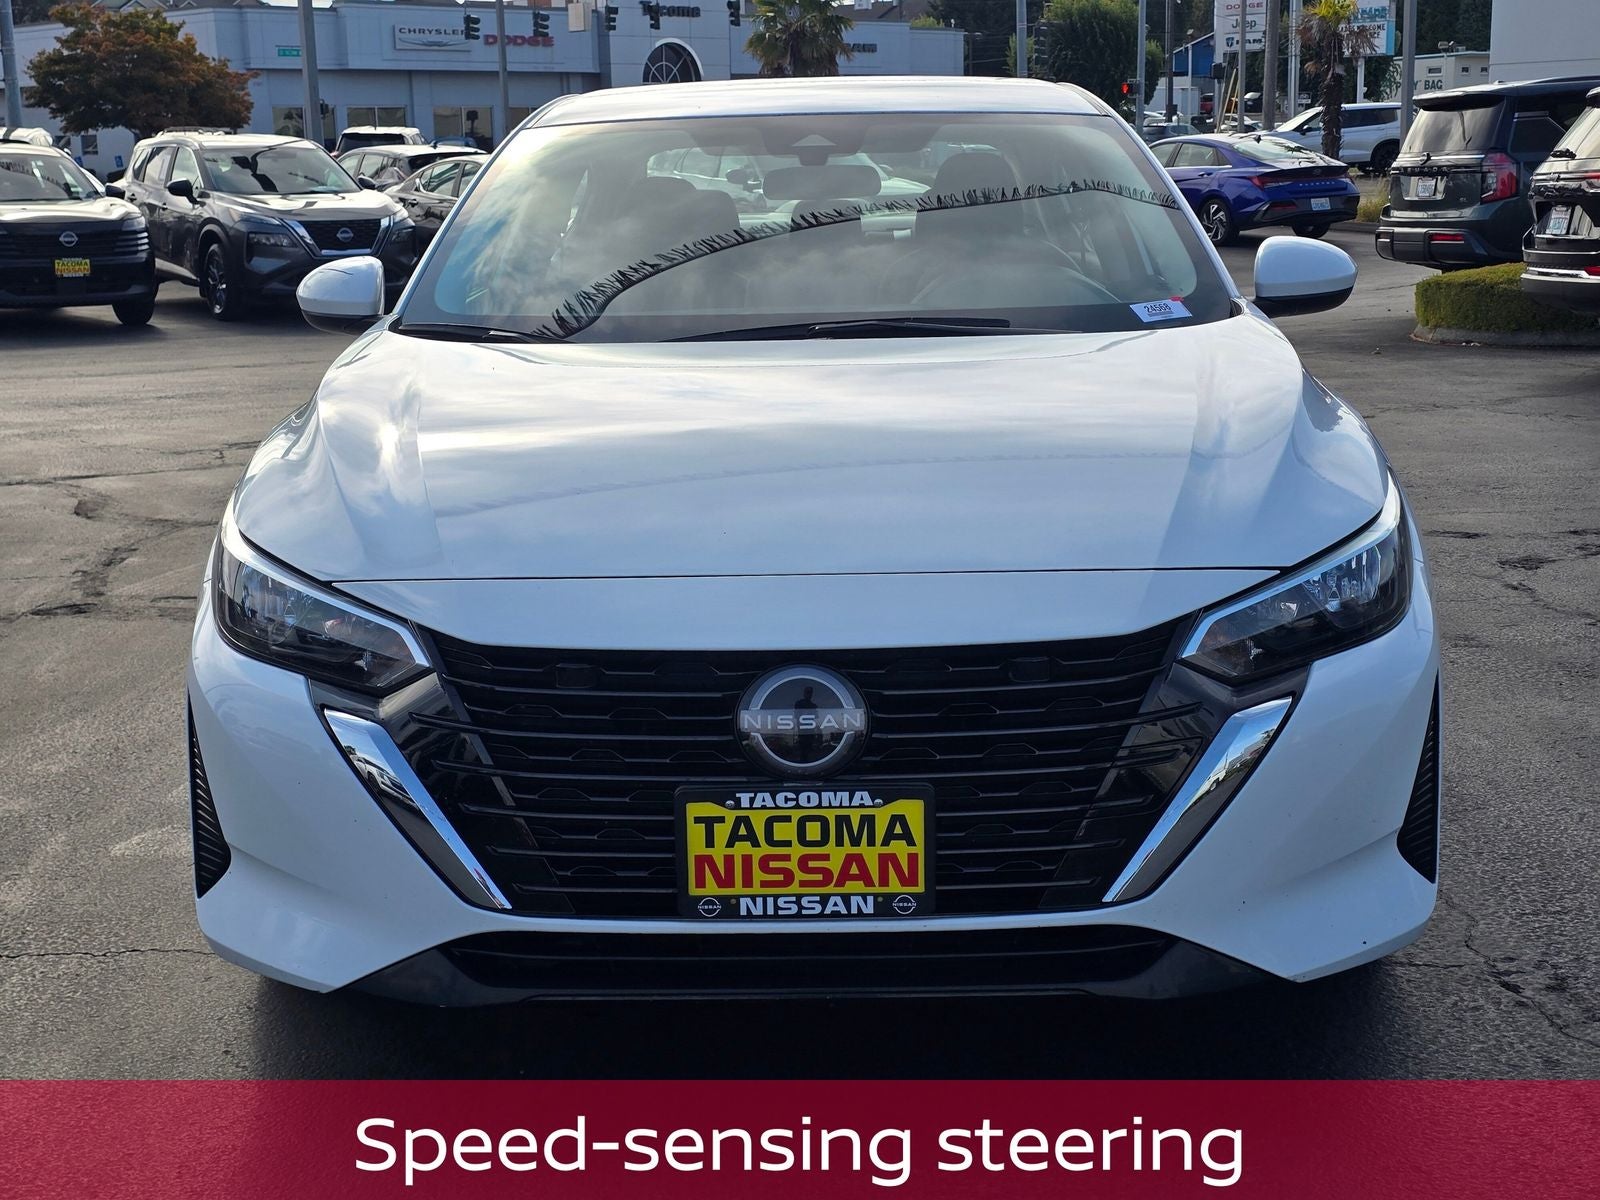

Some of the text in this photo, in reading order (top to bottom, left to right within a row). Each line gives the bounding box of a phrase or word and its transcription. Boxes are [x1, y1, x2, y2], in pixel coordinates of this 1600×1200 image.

[639, 1, 701, 17] Tcoma
[1226, 2, 1263, 10] DOGE
[1231, 18, 1257, 29] Jep
[1395, 79, 1443, 91] PY BAG
[743, 713, 861, 730] NISSAN
[736, 791, 875, 808] TACOMA
[694, 814, 917, 848] TACOMA
[694, 852, 919, 889] NISSAN
[739, 895, 875, 916] NISSAN
